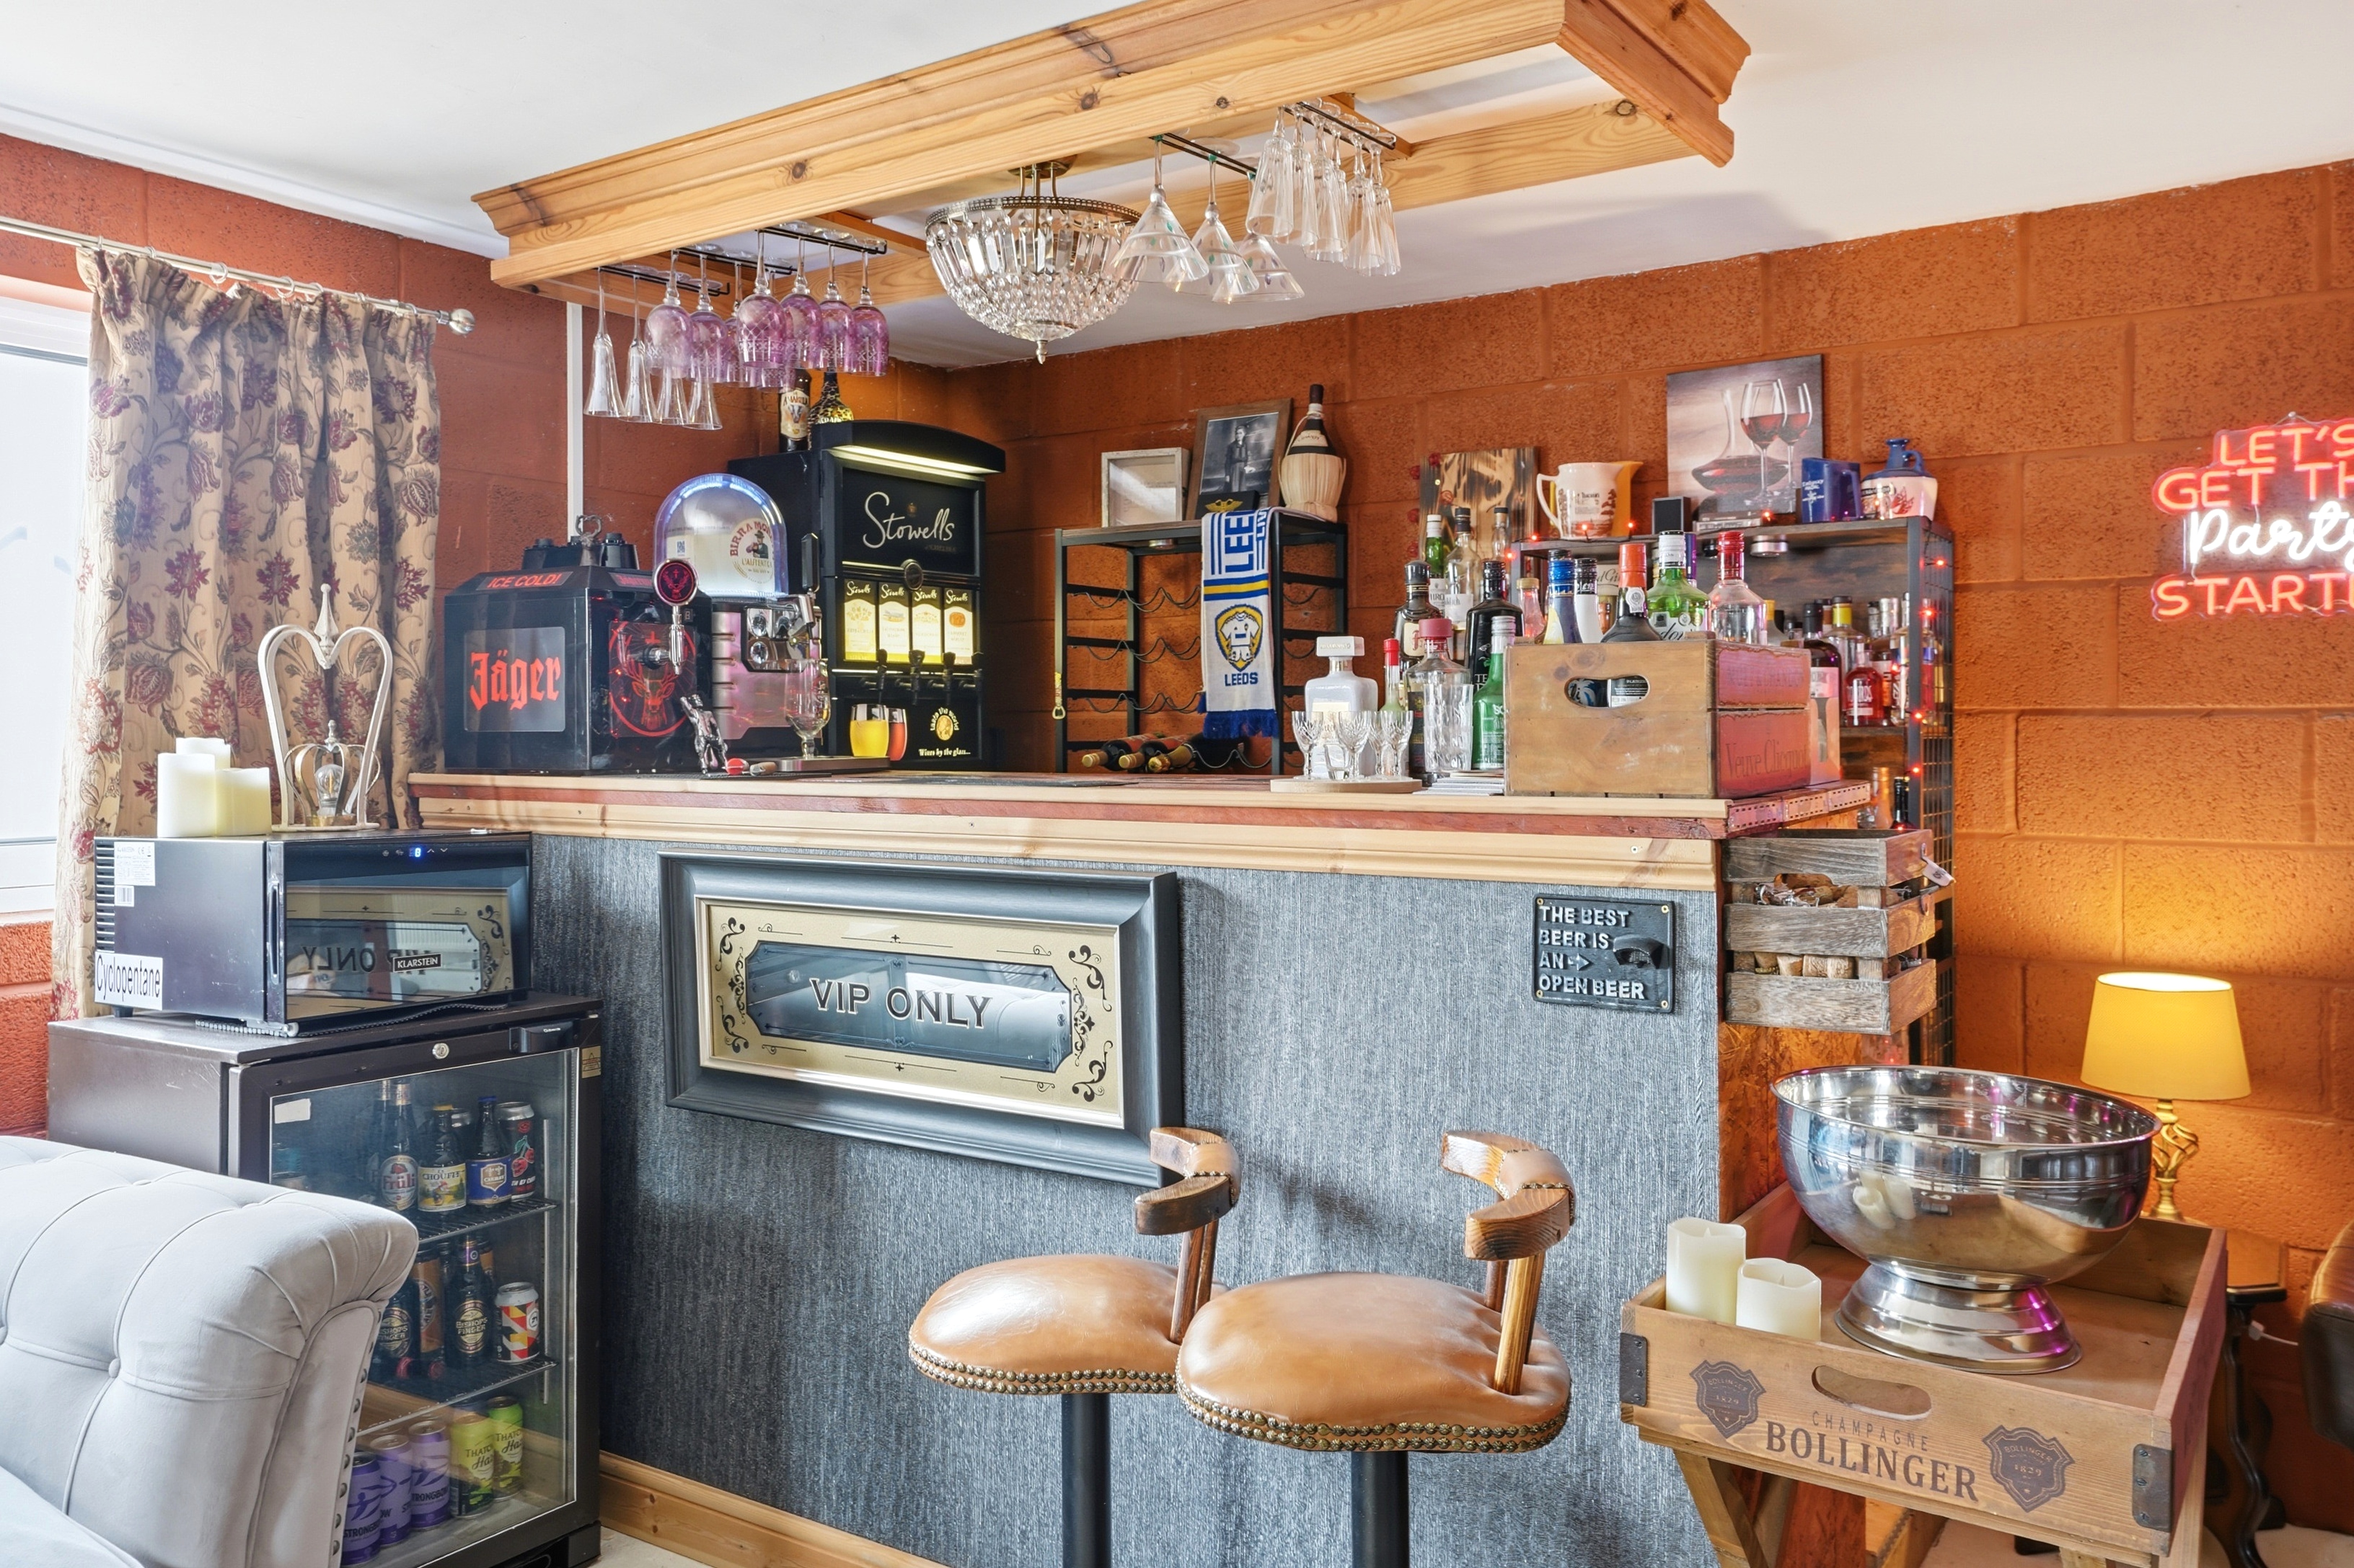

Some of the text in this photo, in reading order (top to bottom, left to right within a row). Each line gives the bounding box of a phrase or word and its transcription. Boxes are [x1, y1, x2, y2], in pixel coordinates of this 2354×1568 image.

[2220, 424, 2354, 466] LET'S
[2158, 467, 2275, 510] GET
[863, 491, 955, 549] Stowells
[2189, 500, 2354, 573] Part
[729, 523, 753, 557] BIRRA
[1225, 510, 1255, 573] LEE
[487, 573, 563, 588] ICE COLD!
[2156, 572, 2354, 616] START
[469, 649, 561, 711] Jäger
[1224, 671, 1259, 687] LEEDS
[936, 748, 943, 757] by
[1539, 906, 1629, 928] THE BEST
[1539, 929, 1609, 950] BEER IS
[96, 954, 160, 1002] Cyclopentane
[397, 957, 438, 969] KLARSTEIN
[1539, 951, 1564, 970] AN
[808, 977, 993, 1029] VIP ONLY
[1539, 974, 1645, 1000] OPEN BEER
[1812, 1411, 1928, 1452] CHAMPAGNE
[1766, 1420, 1979, 1502] BOLLINGER
[2004, 1445, 2053, 1462] BOLLINGER
[2014, 1464, 2042, 1477] 1829
